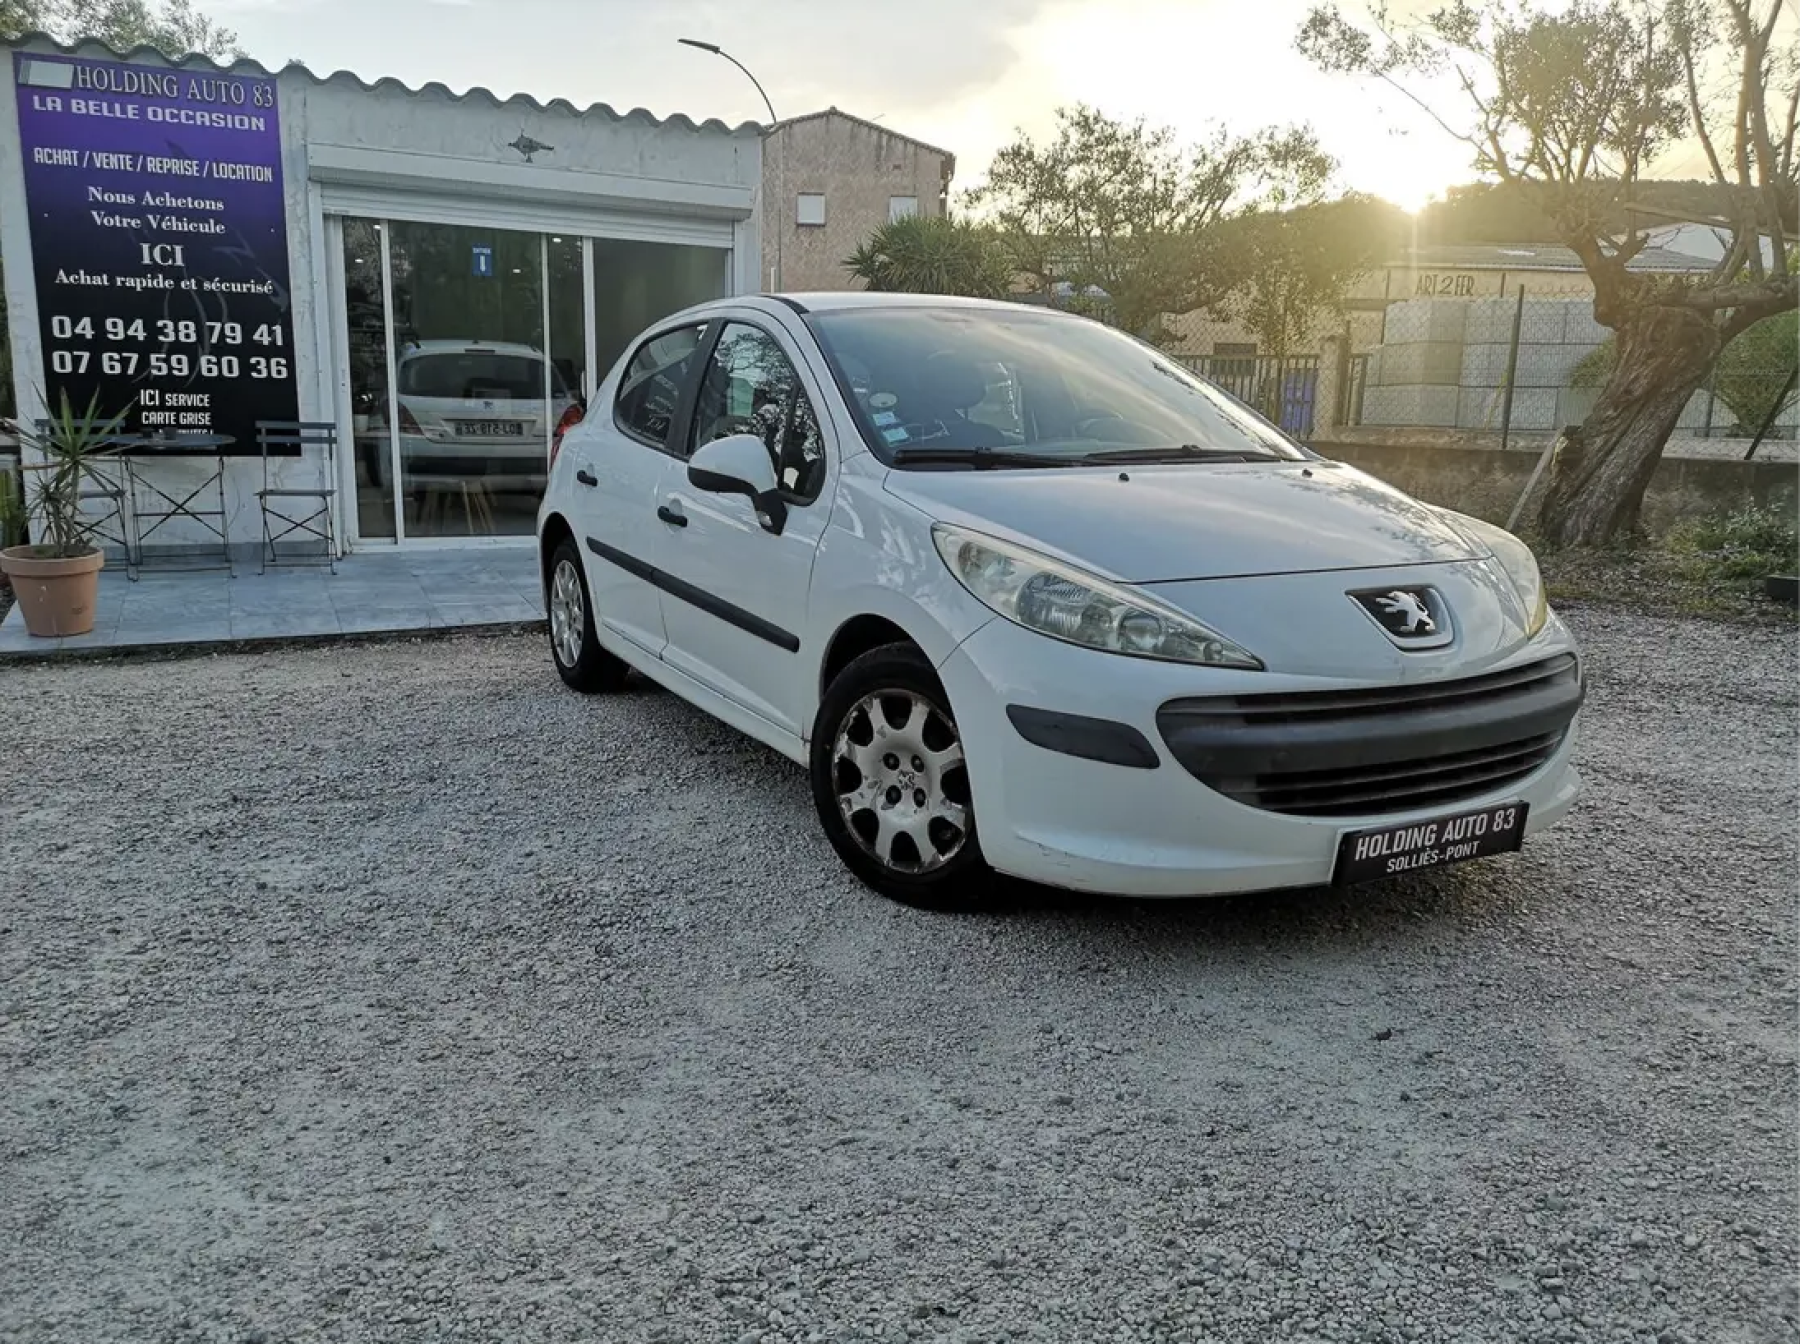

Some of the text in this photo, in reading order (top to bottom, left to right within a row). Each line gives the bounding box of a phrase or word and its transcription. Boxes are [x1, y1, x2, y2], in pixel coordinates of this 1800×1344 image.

[77, 66, 274, 108] HOLDING AUTO 83
[33, 95, 266, 131] LA BELLE OCCASION
[33, 147, 79, 167] ACHAT
[92, 151, 133, 171] VENTE
[147, 157, 200, 177] REPRISE
[213, 162, 273, 183] LOCATION
[88, 186, 225, 211] Nous Achetons
[91, 210, 226, 234] Votre Véhicule
[139, 243, 185, 267] ICI
[54, 268, 274, 294] Achat rapide et sécurisé
[51, 315, 284, 346] 04 94 38 79 41
[51, 350, 288, 379] 07 67 59 60 36
[140, 388, 210, 408] ICI SERVICE
[141, 411, 212, 426] CARTE GRISE
[1355, 807, 1516, 862] HOLDING AUTO 83
